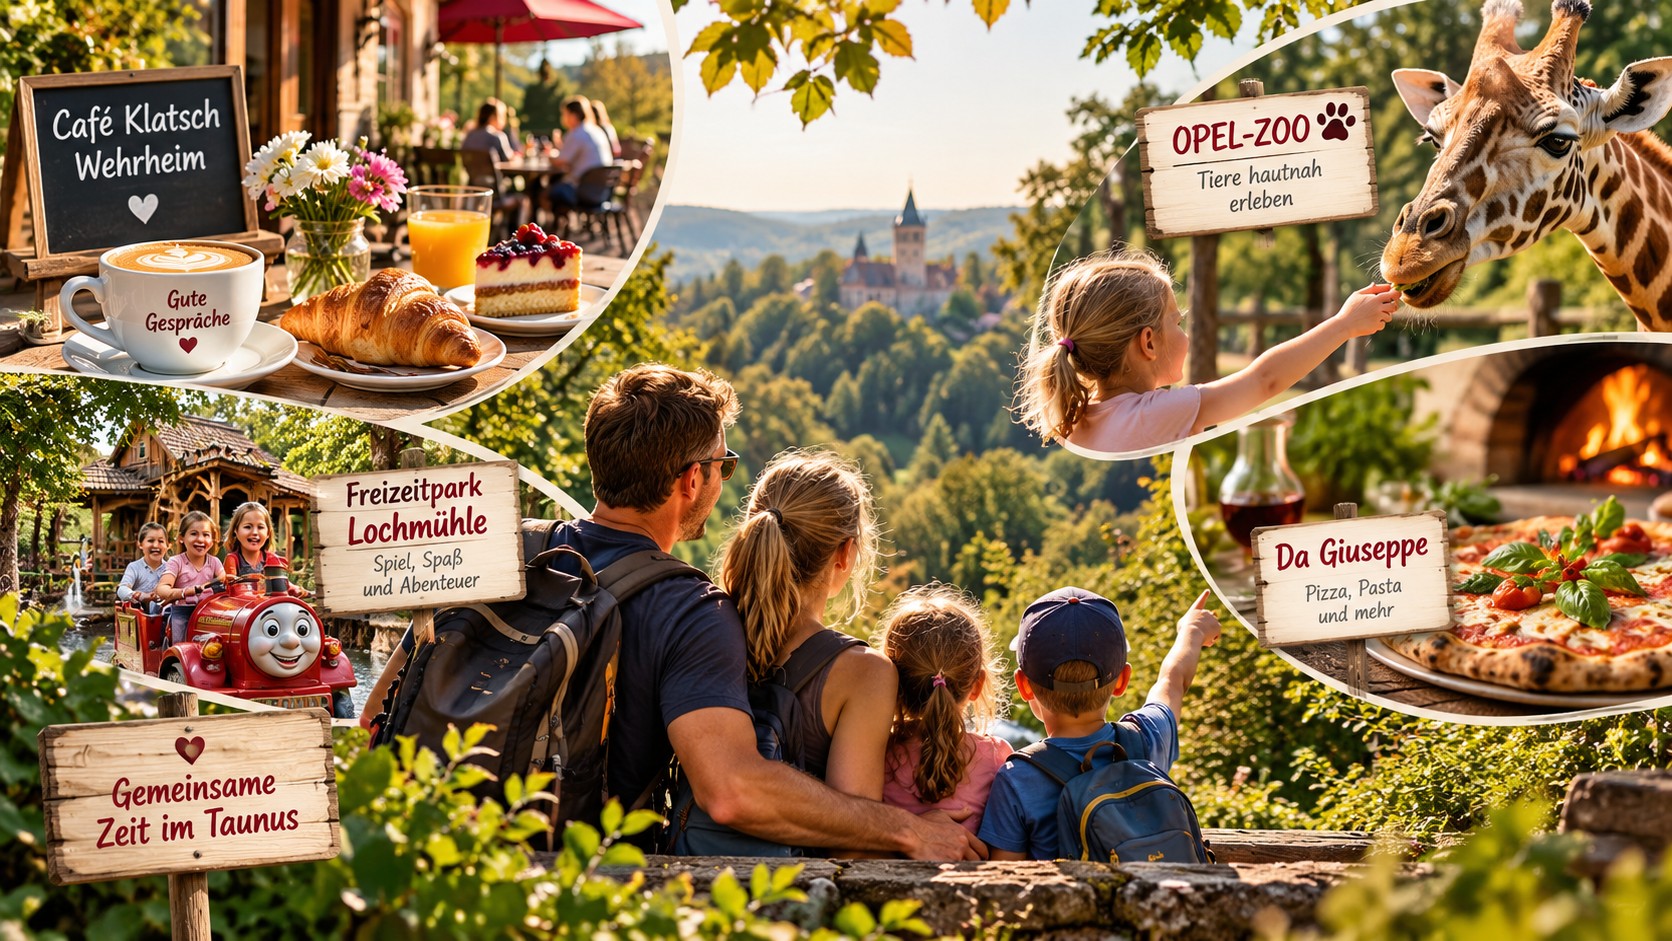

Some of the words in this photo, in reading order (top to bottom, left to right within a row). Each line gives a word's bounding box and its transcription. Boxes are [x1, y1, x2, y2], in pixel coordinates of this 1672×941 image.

[53, 106, 113, 143] Café
[125, 98, 220, 135] Klatsch
[1172, 114, 1310, 155] OPEL-ZOO
[75, 144, 206, 181] Wehrheim
[1197, 170, 1241, 190] Tiere
[1249, 158, 1322, 185] hautnah
[1229, 190, 1294, 213] erleben
[167, 289, 207, 310] Gute
[145, 308, 231, 336] Gespräche
[346, 472, 482, 508] Freizeitpark
[347, 505, 488, 547] Lochmühle
[373, 553, 415, 577] Spiel,
[422, 548, 463, 573] Spaß
[1275, 542, 1310, 571] Da
[1319, 537, 1428, 569] Giuseppe
[363, 579, 393, 597] und
[399, 574, 480, 595] Abenteuer
[1305, 584, 1352, 602] Pizza,
[1358, 578, 1402, 596] Pasta
[1318, 605, 1348, 624] und
[1355, 602, 1395, 620] mehr
[112, 774, 276, 811] Gemeinsame
[96, 817, 151, 849] Zeit
[162, 814, 194, 842] im
[204, 807, 299, 838] Taunus
